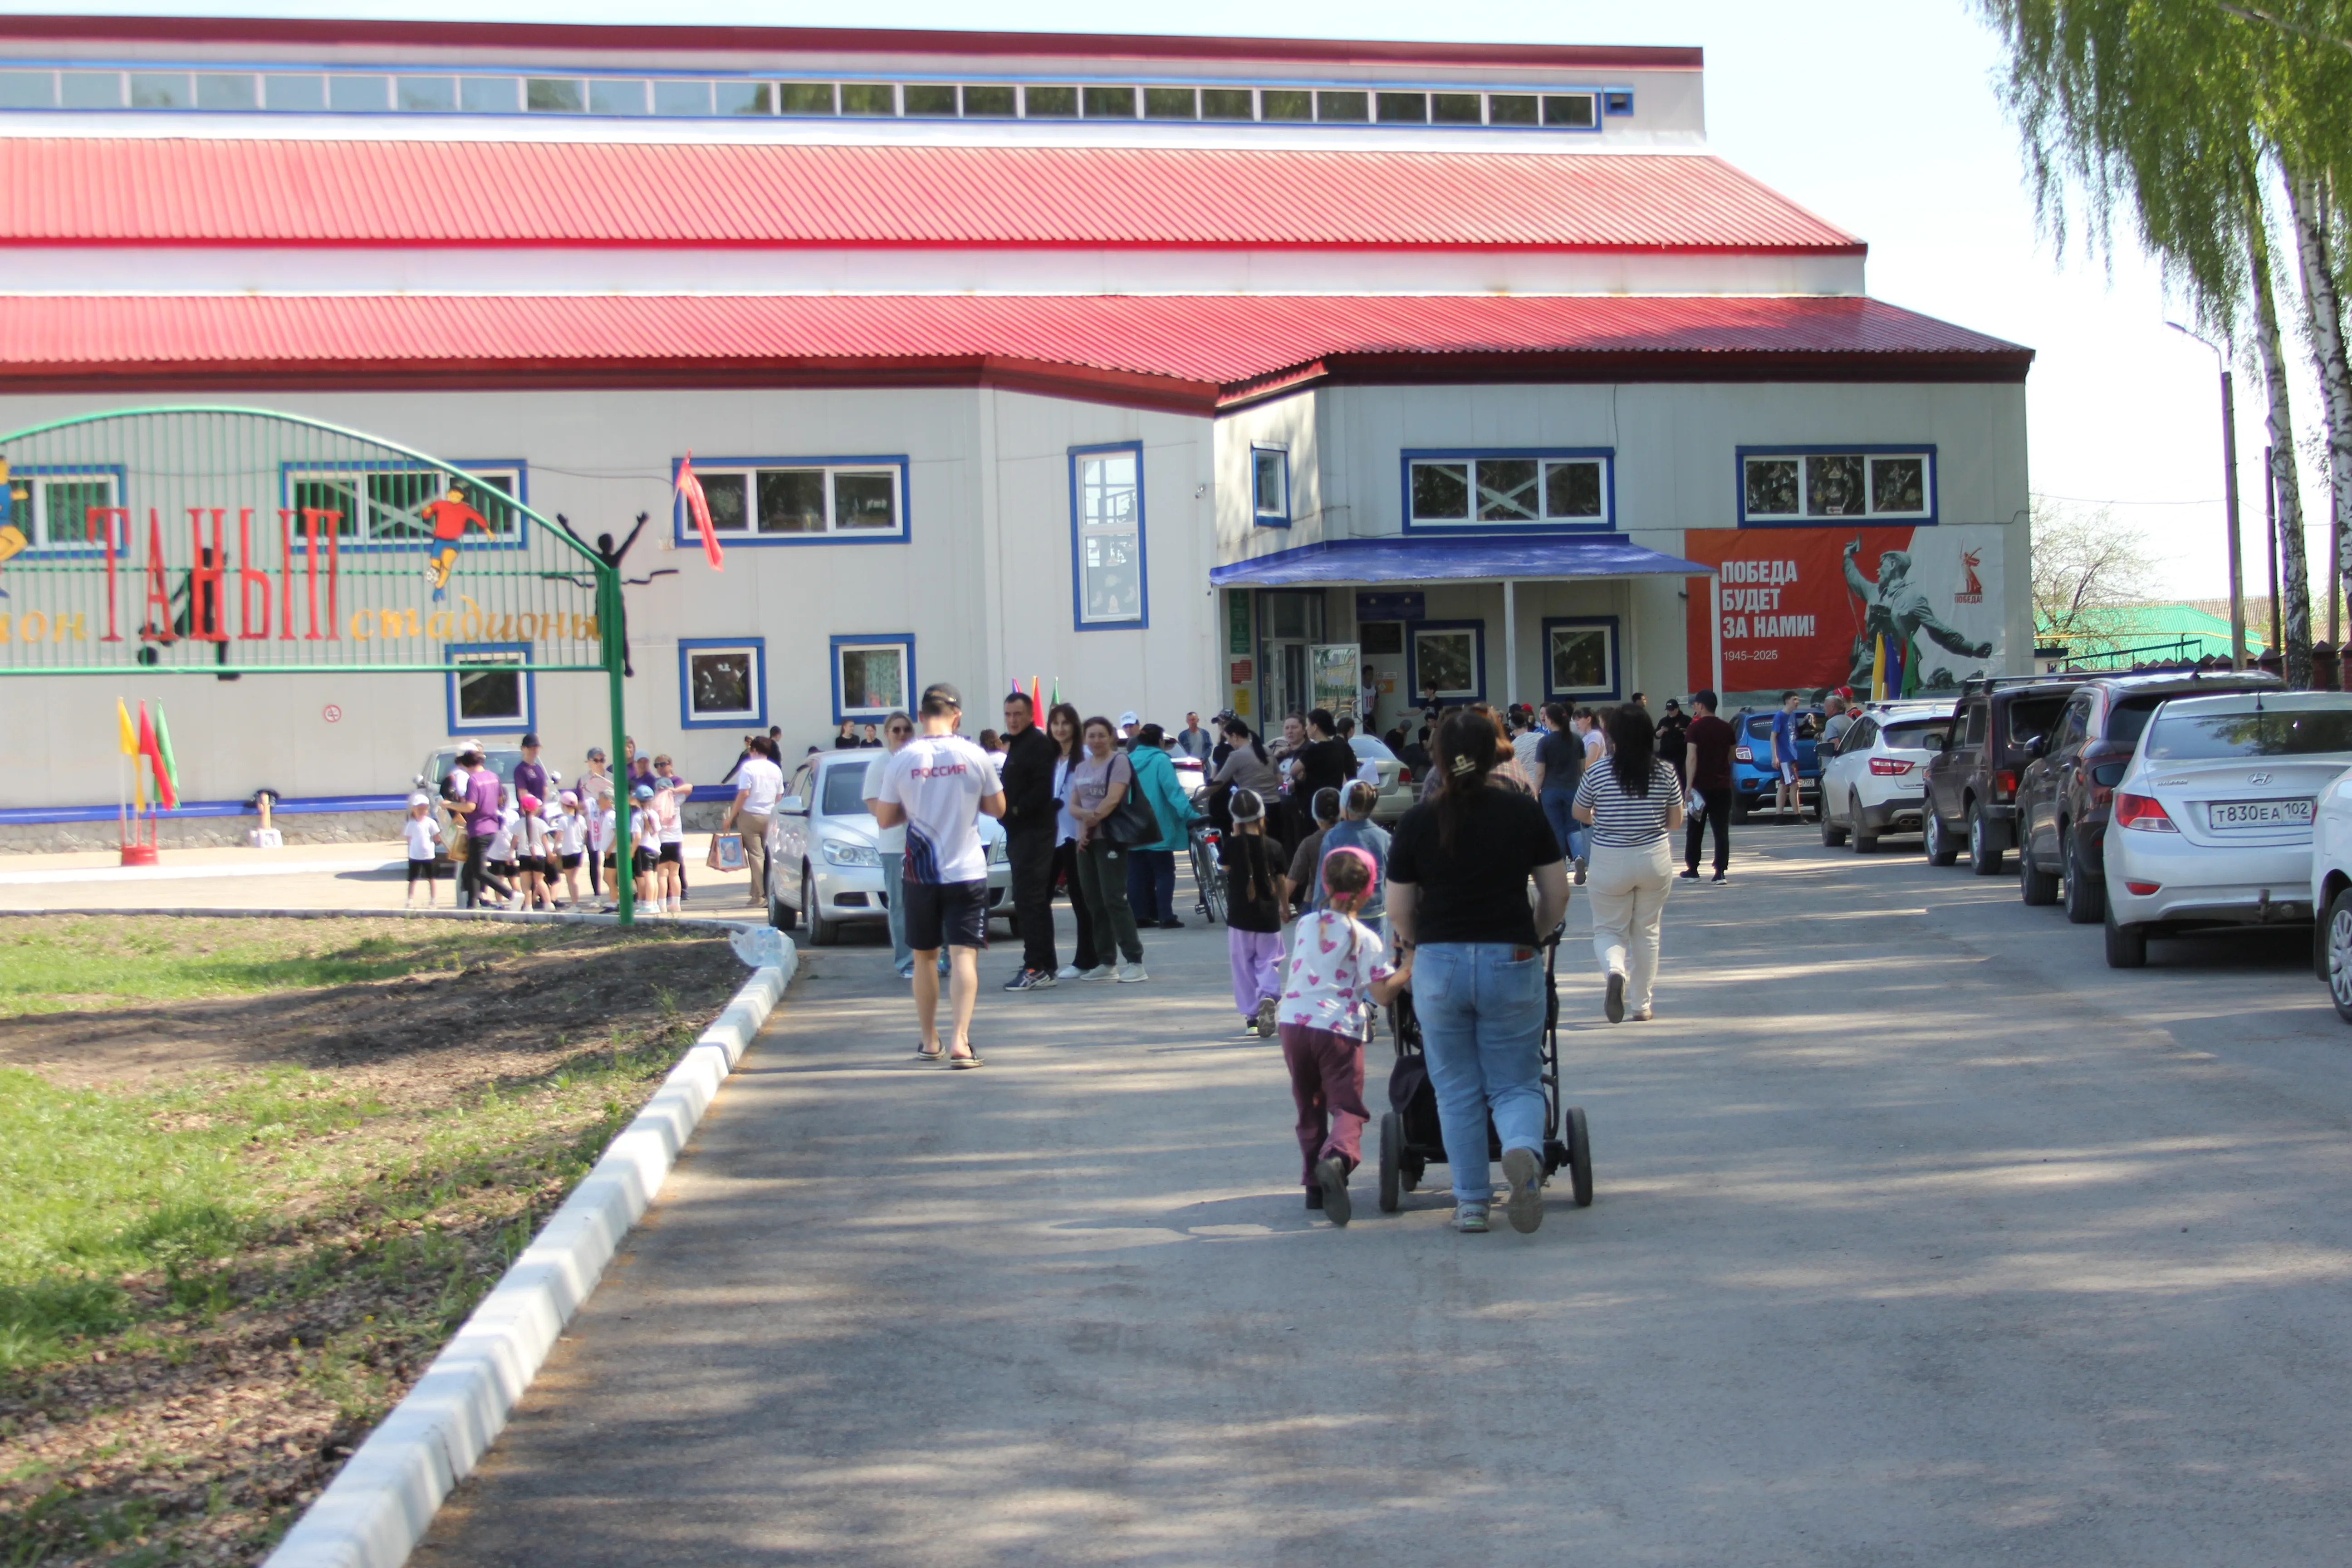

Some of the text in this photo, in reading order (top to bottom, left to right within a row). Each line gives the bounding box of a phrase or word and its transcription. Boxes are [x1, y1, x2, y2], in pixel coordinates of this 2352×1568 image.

[85, 507, 344, 642] ТАНЫП
[350, 595, 603, 642] стадионы
[1721, 560, 1798, 586] ПОБЕДА
[1722, 589, 1780, 614] БУДЕТ
[1954, 595, 1983, 604] ПОБЕДА!
[1723, 615, 1815, 639] ЗА НАМИ!
[911, 764, 967, 779] РОССИЯ
[2284, 802, 2308, 815] 102
